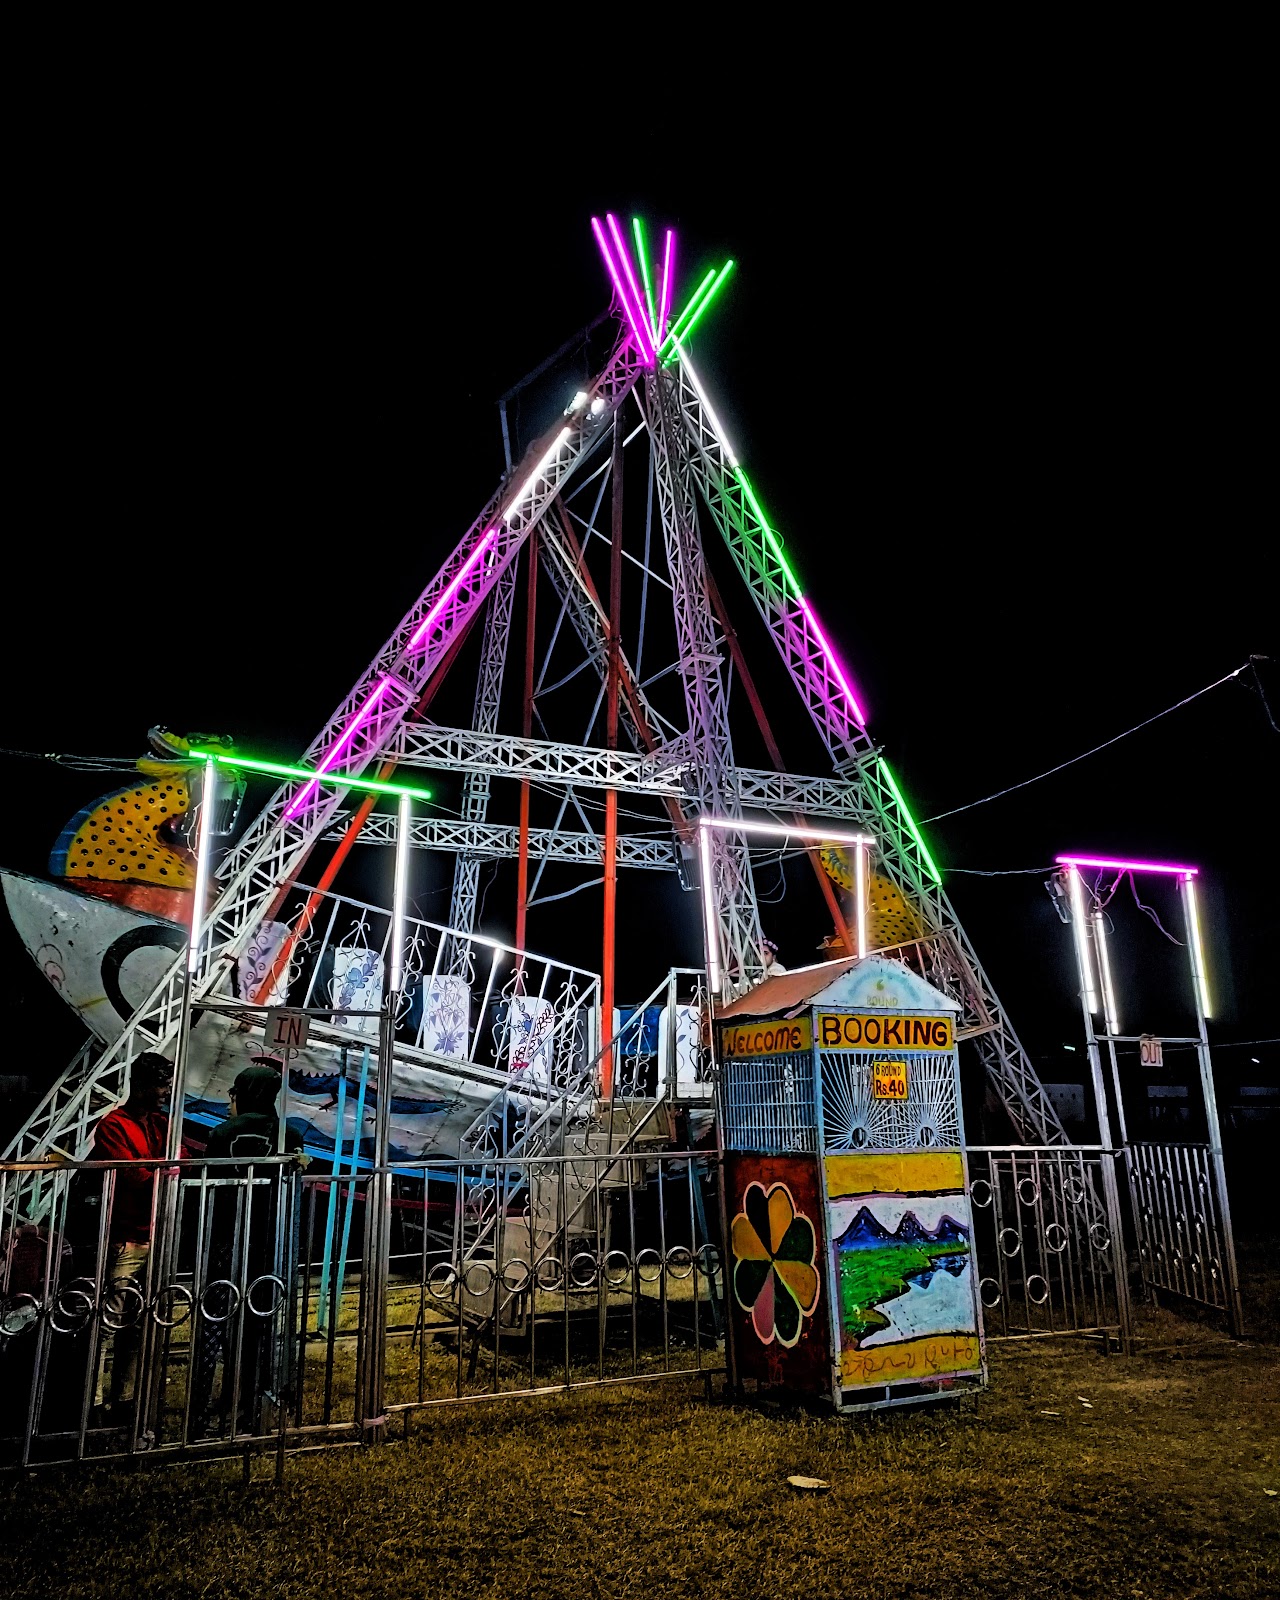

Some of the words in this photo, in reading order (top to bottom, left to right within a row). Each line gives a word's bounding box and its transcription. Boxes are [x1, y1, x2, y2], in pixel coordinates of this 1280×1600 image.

[273, 1016, 302, 1046] IN
[724, 1026, 802, 1056] WELCOME
[822, 1016, 948, 1047] BOOKING
[1141, 1042, 1162, 1065] OUT
[875, 1063, 881, 1076] 6
[881, 1065, 901, 1077] ROUND
